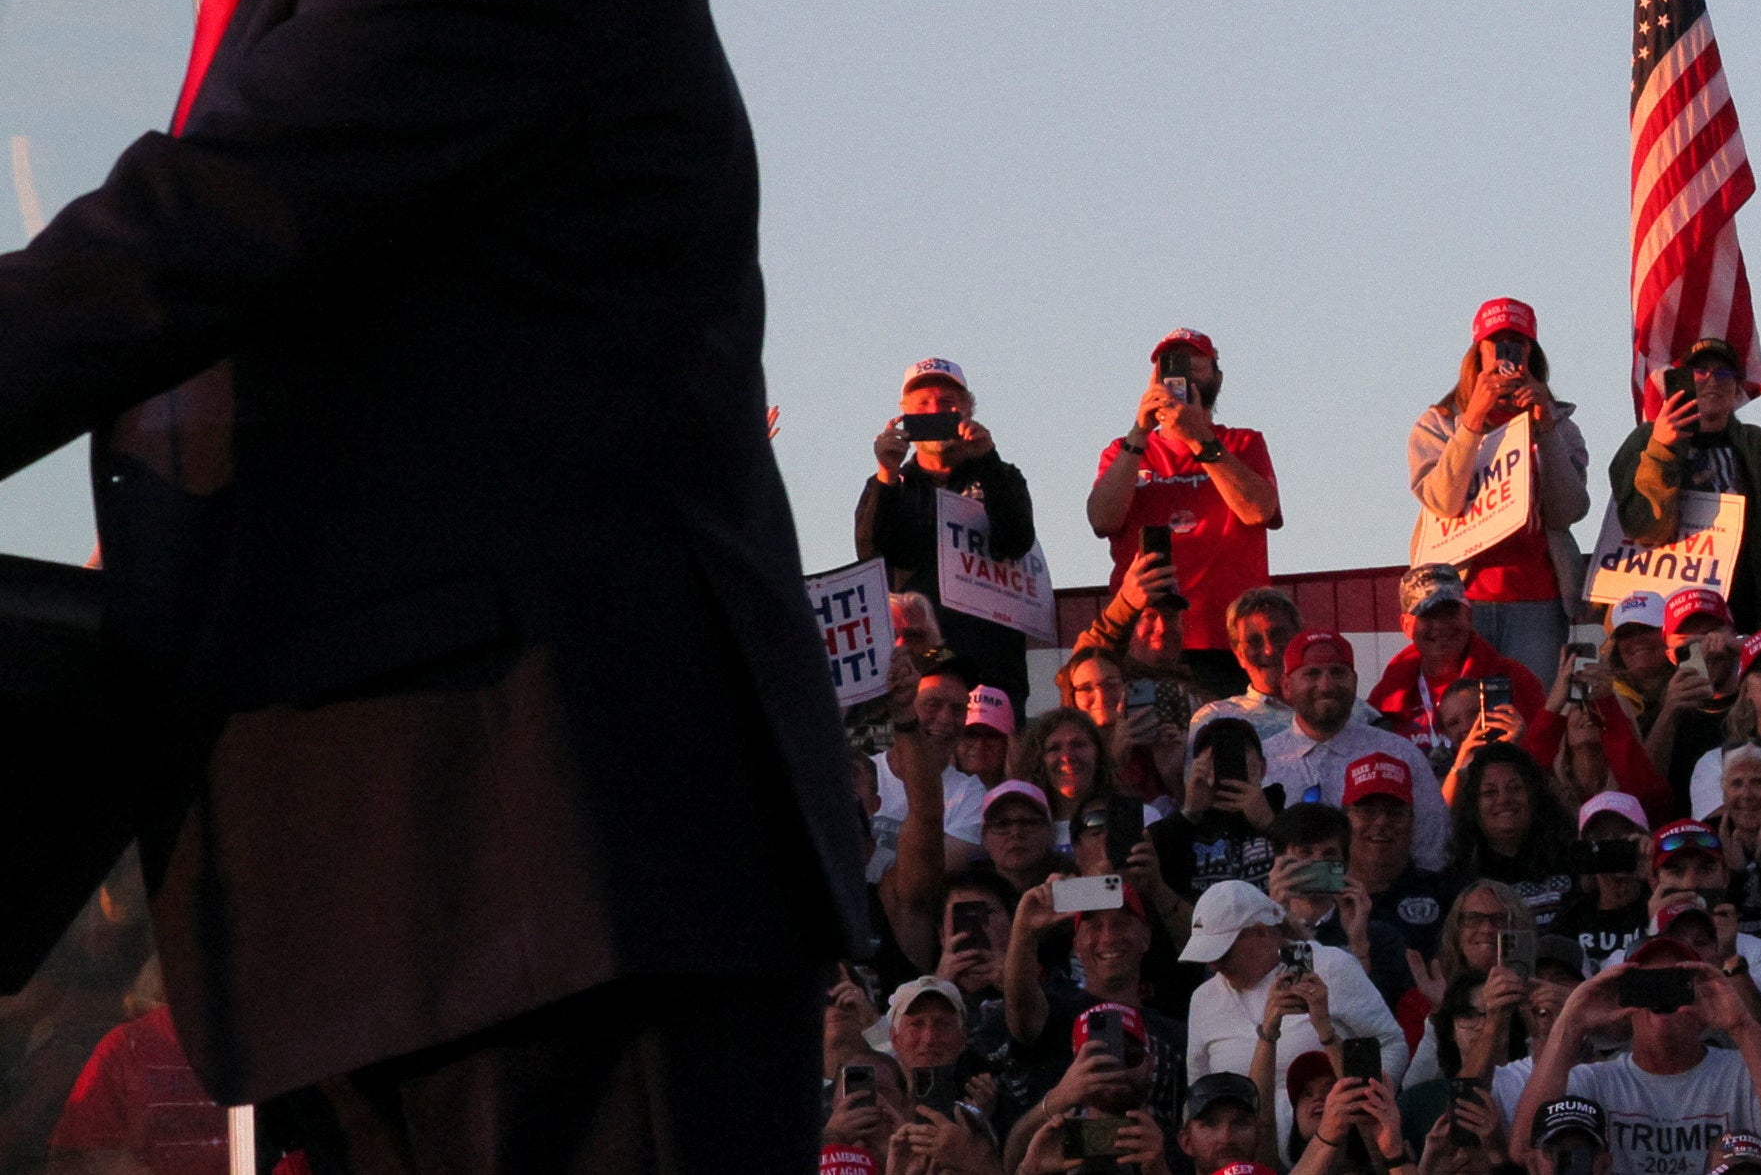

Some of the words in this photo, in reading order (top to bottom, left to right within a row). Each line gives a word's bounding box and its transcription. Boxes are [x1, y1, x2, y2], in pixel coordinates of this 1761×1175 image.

[1440, 481, 1513, 538] VANCE
[946, 521, 1044, 578] TRP
[1601, 547, 1723, 587] TRUMP
[960, 552, 1039, 600] VANCE
[1547, 1100, 1597, 1115] TRUMP
[1612, 1122, 1723, 1154] TRUMP
[829, 1151, 872, 1166] AMERICA
[1223, 1163, 1255, 1175] KEEP
